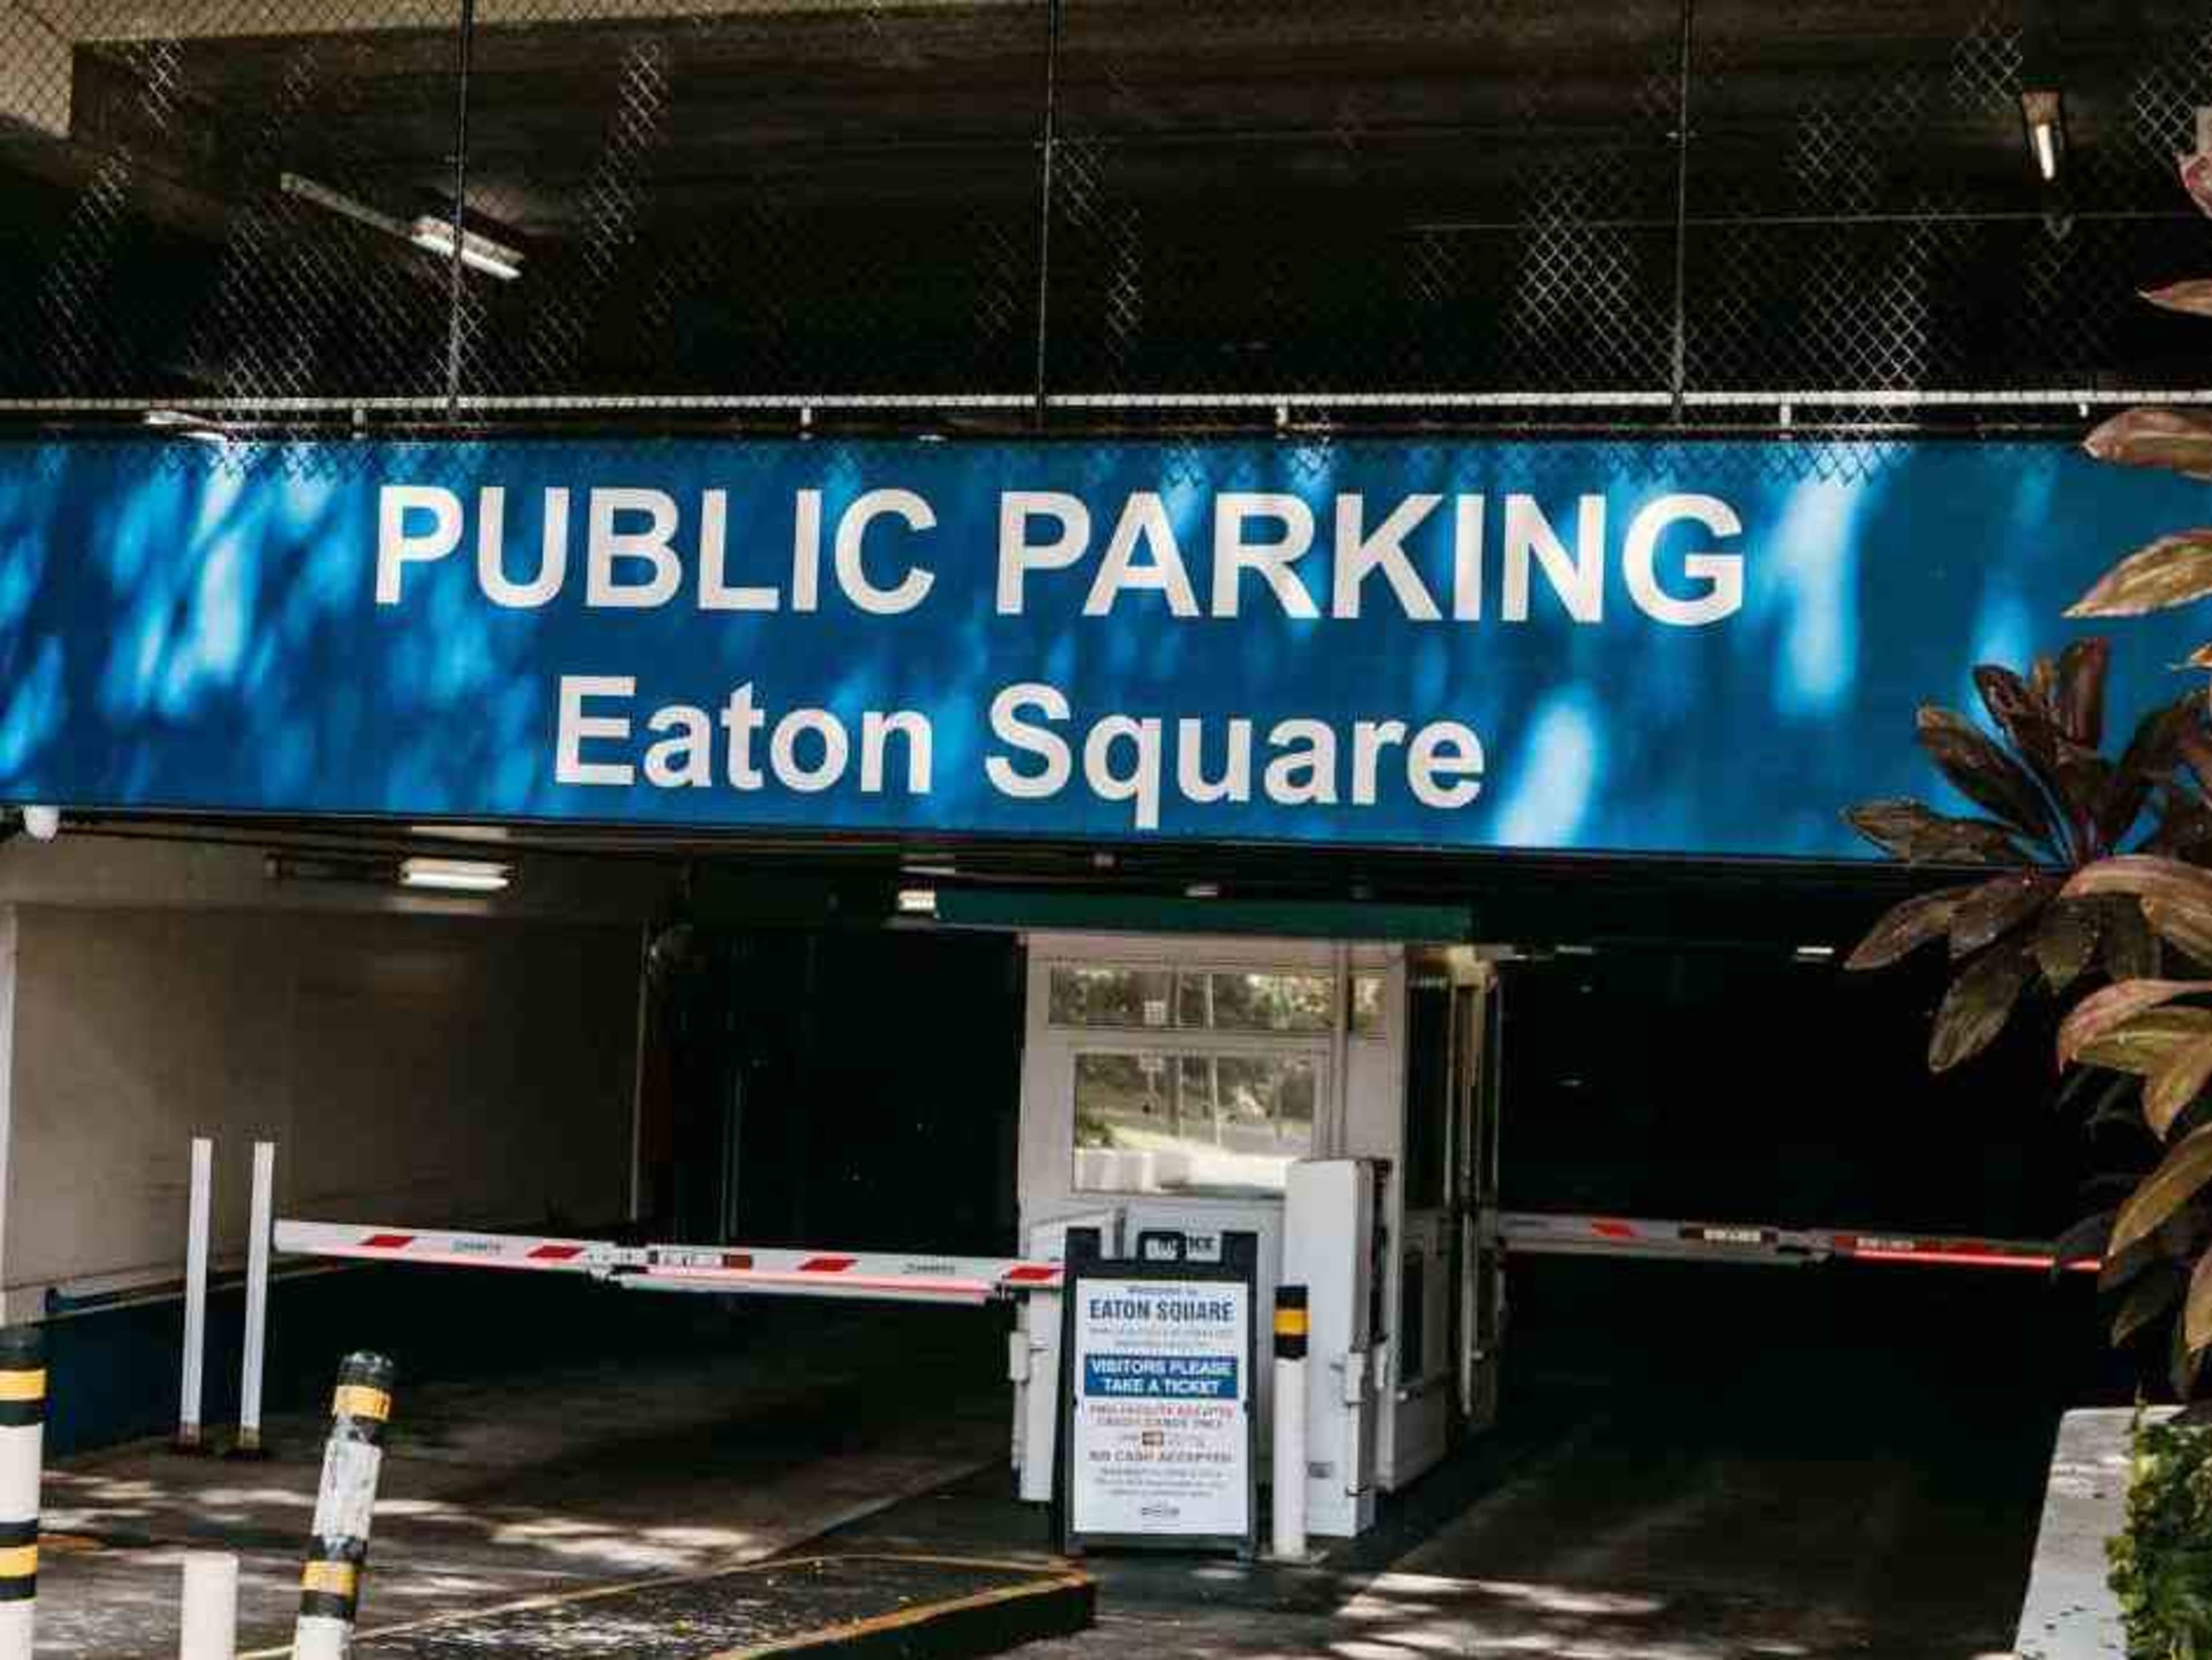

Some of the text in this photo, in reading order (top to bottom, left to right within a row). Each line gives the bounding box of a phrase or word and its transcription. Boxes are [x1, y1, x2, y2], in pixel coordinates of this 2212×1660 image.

[376, 485, 1744, 626] PUBLIC PARKING
[555, 675, 1485, 829] Eaton Square
[1089, 1299, 1234, 1322] EATON SQUARE
[1092, 1359, 1232, 1376] VISITORS PLEASE
[1104, 1379, 1219, 1394] TAKE A TICKET
